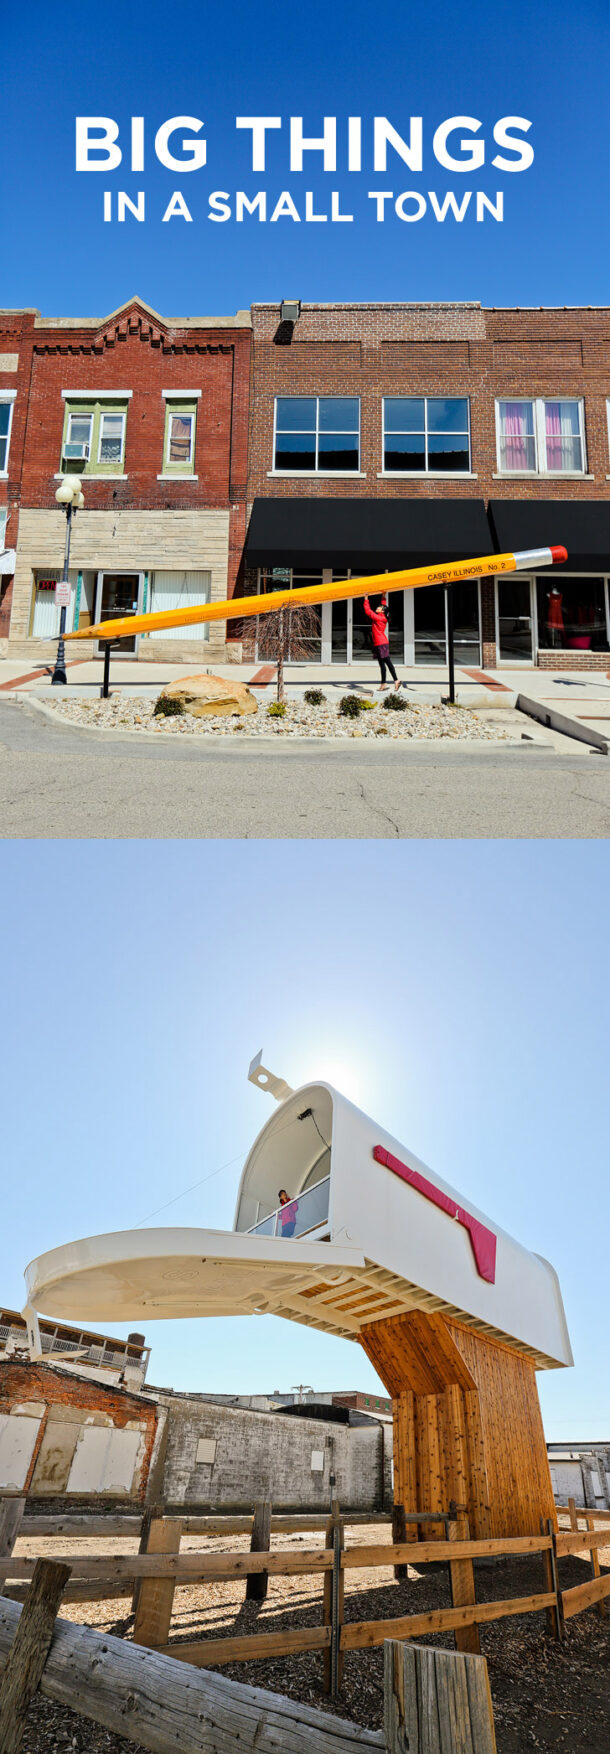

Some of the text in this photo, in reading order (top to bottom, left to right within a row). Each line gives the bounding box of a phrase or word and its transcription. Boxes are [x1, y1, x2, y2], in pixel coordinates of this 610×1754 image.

[427, 571, 452, 581] CASEY
[453, 566, 483, 577] ILLINOIS
[38, 580, 57, 591] OPEN
